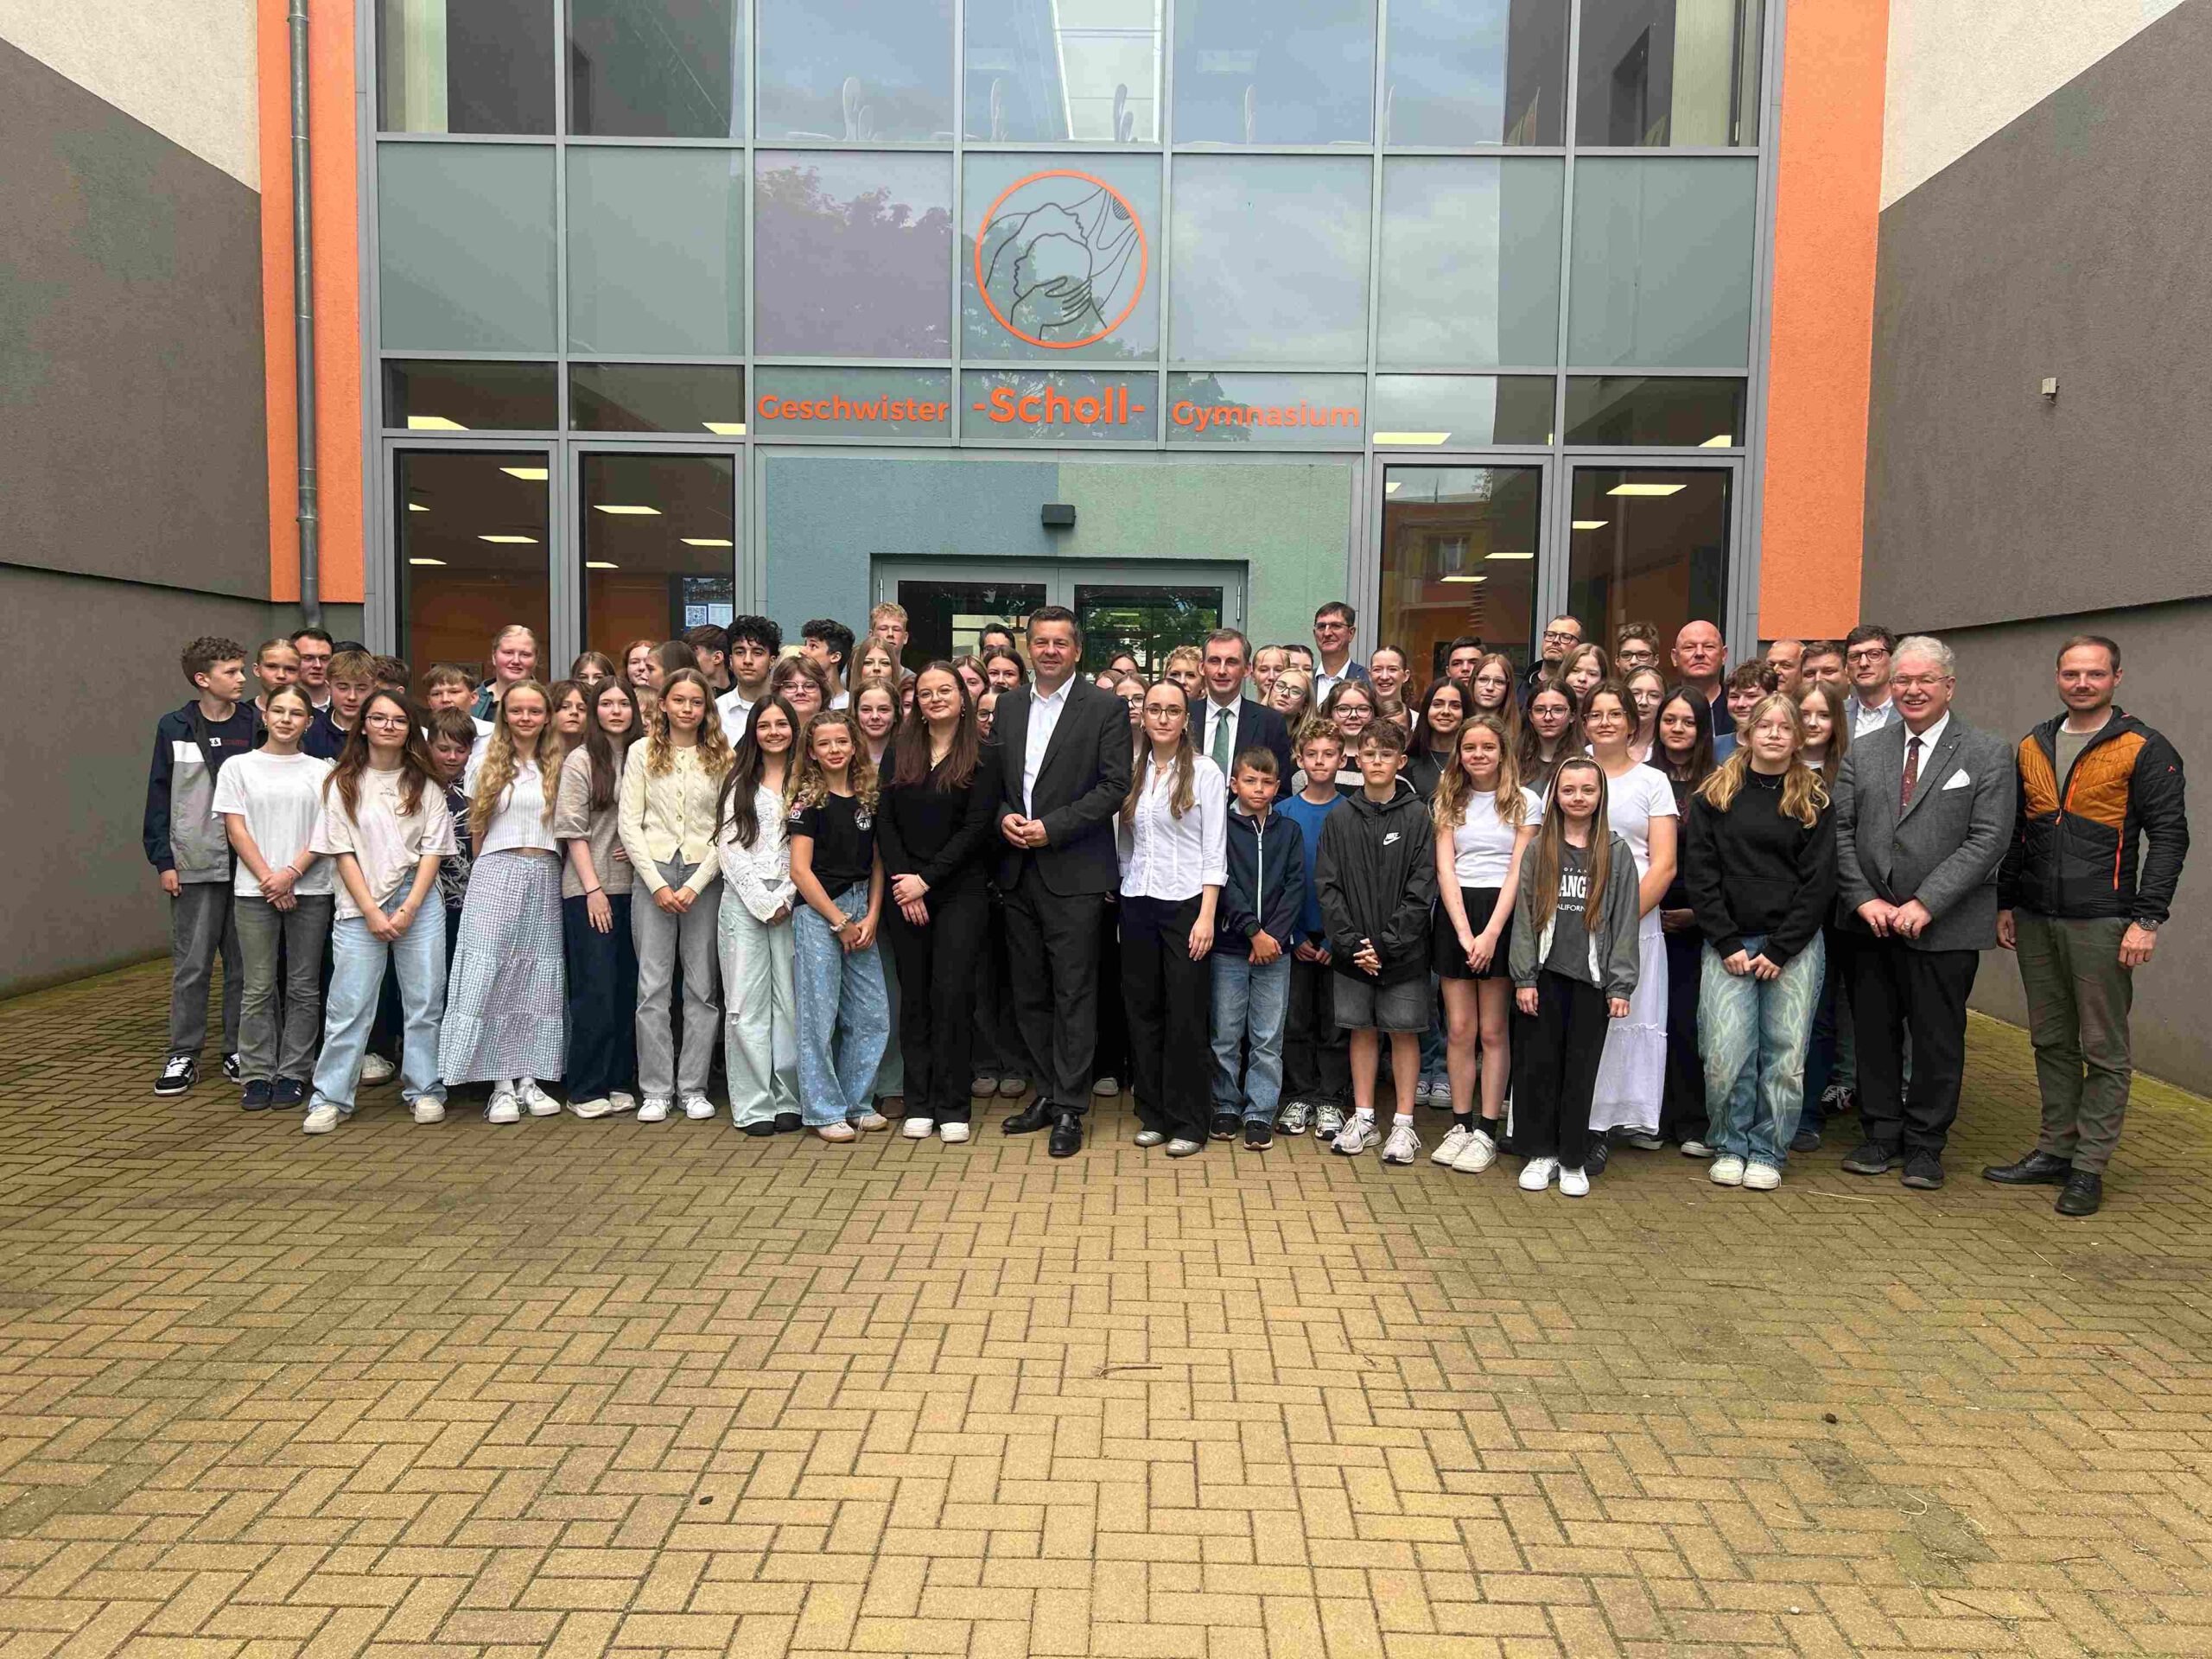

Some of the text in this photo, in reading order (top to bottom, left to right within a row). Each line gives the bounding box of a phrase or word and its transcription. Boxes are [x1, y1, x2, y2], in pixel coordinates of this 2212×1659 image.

[757, 394, 949, 422] Geschwister
[1171, 398, 1360, 432] Gymnasium
[1558, 874, 1587, 899] ANG
[1556, 903, 1586, 912] ALIFORN
